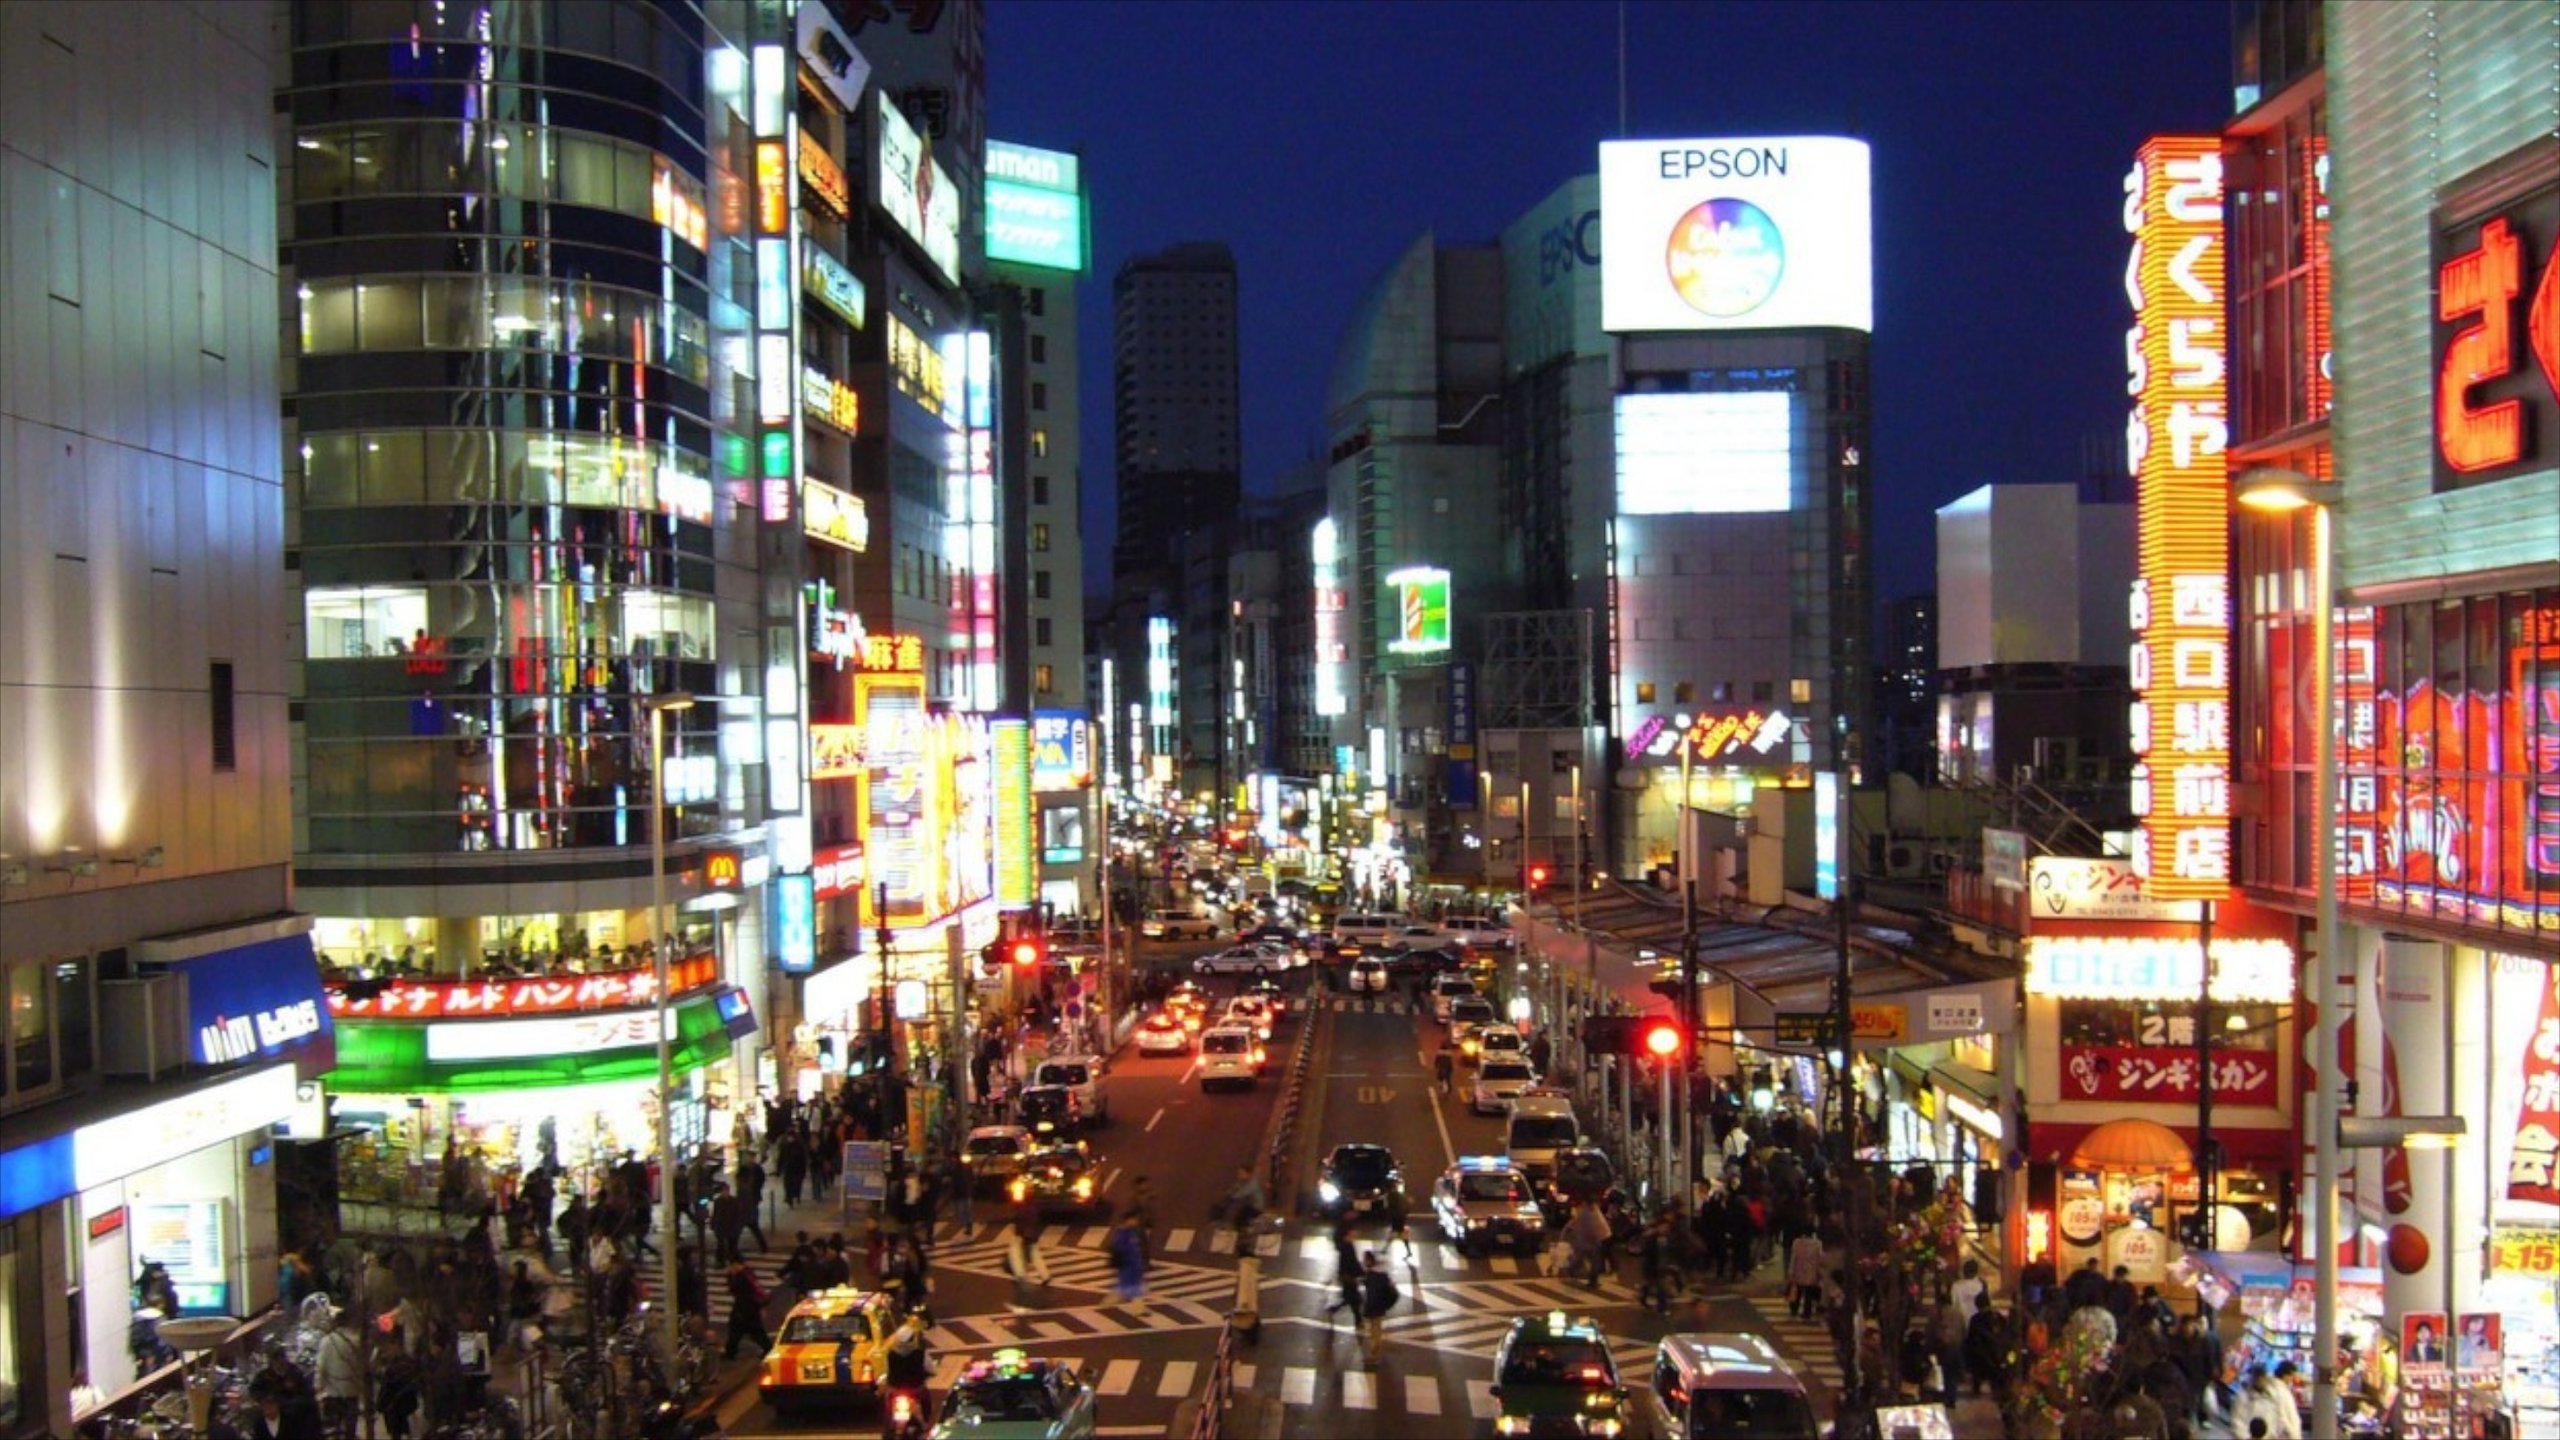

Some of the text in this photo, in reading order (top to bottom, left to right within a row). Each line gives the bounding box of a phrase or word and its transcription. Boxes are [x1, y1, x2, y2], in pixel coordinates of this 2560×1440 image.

[1660, 147, 1787, 179] EPSON
[2164, 152, 2228, 879] さくらや 西口駅前店
[862, 634, 922, 671] 麻雀
[2141, 1016, 2195, 1046] 2階
[2117, 1057, 2268, 1091] ジンギスカン
